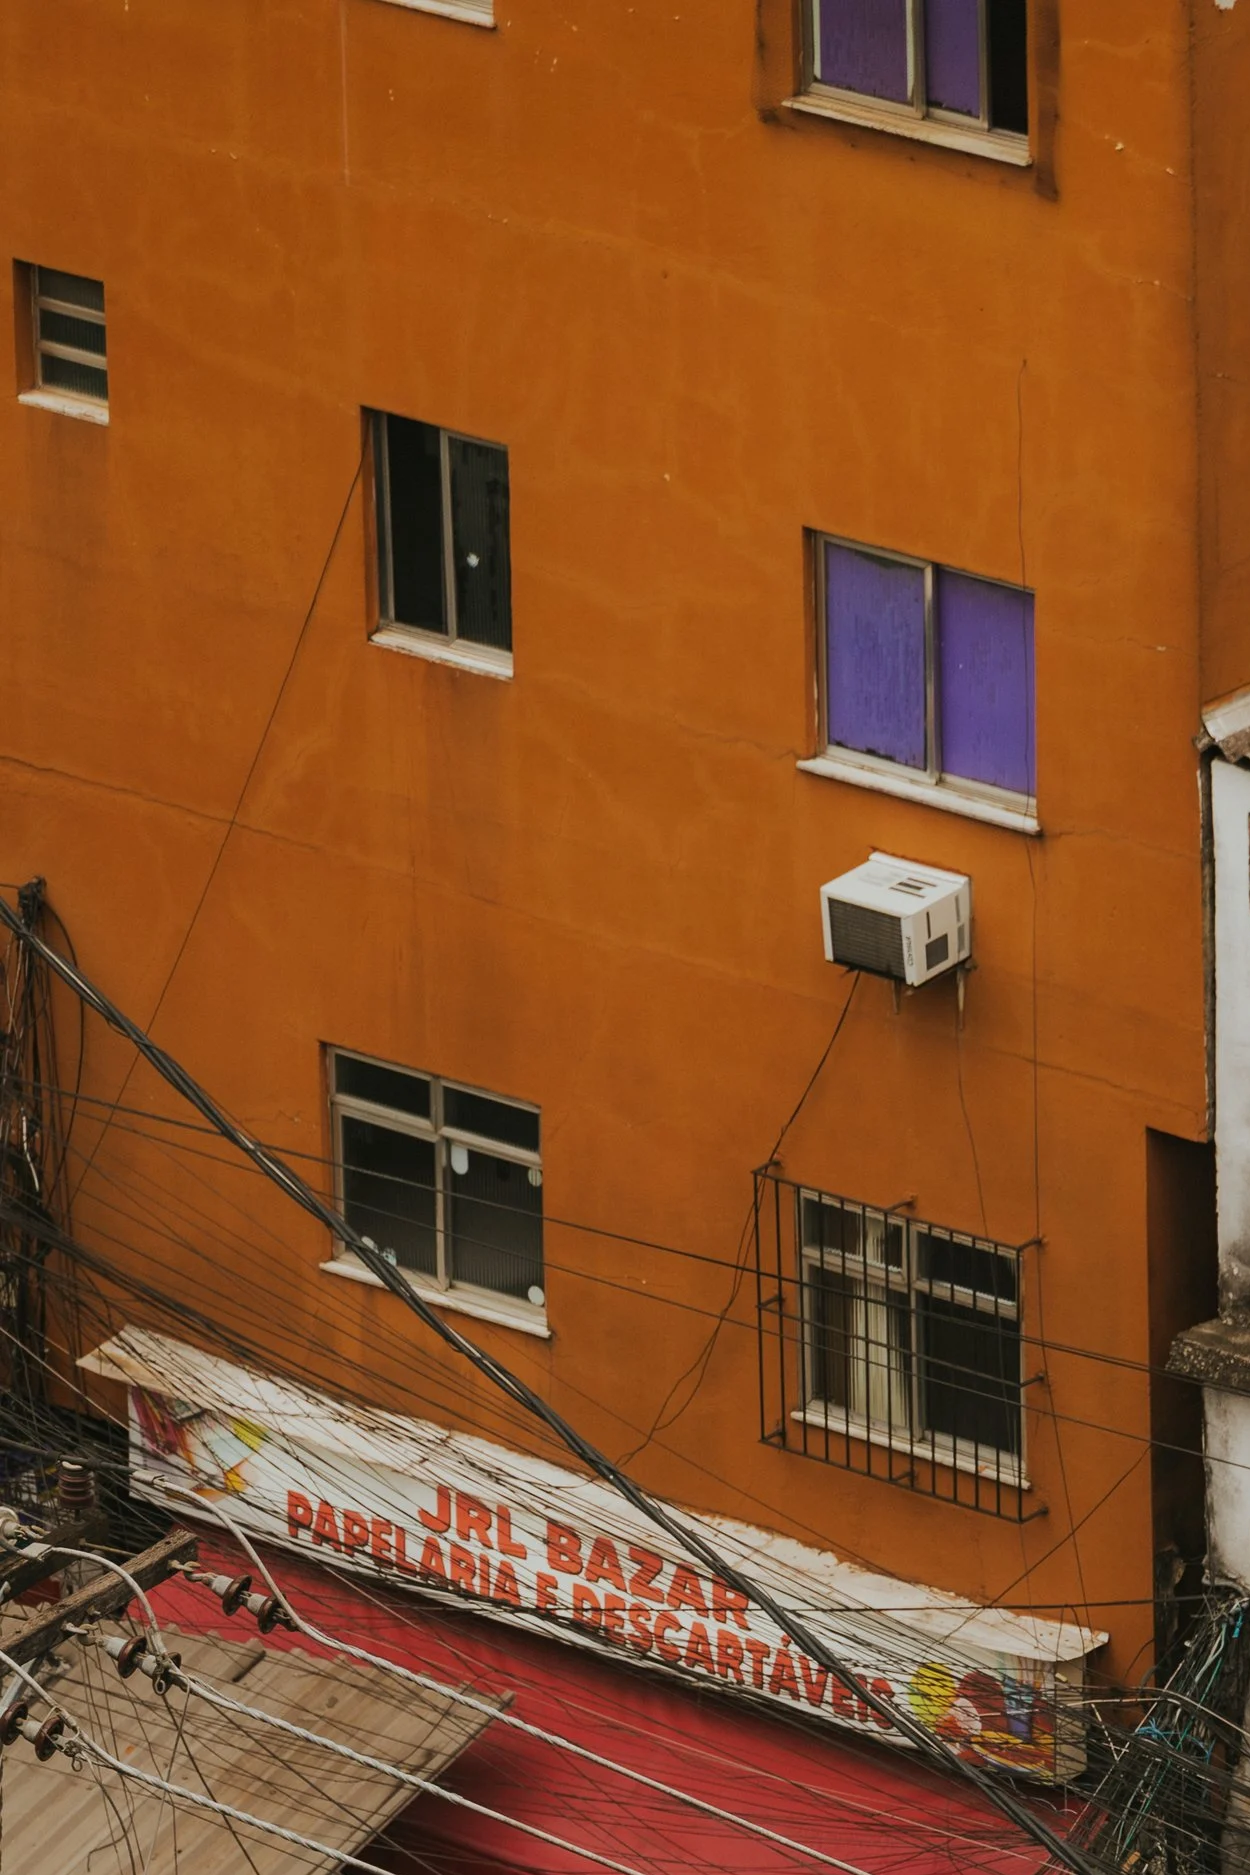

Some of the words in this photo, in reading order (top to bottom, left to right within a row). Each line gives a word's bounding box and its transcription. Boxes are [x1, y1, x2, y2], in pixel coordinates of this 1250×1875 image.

[286, 1490, 522, 1607] PAPELARIA
[535, 1571, 560, 1616] E
[572, 1581, 897, 1731] DESCARTÁVEIS
[418, 1485, 528, 1560] JRL
[546, 1519, 749, 1631] BAZAR
